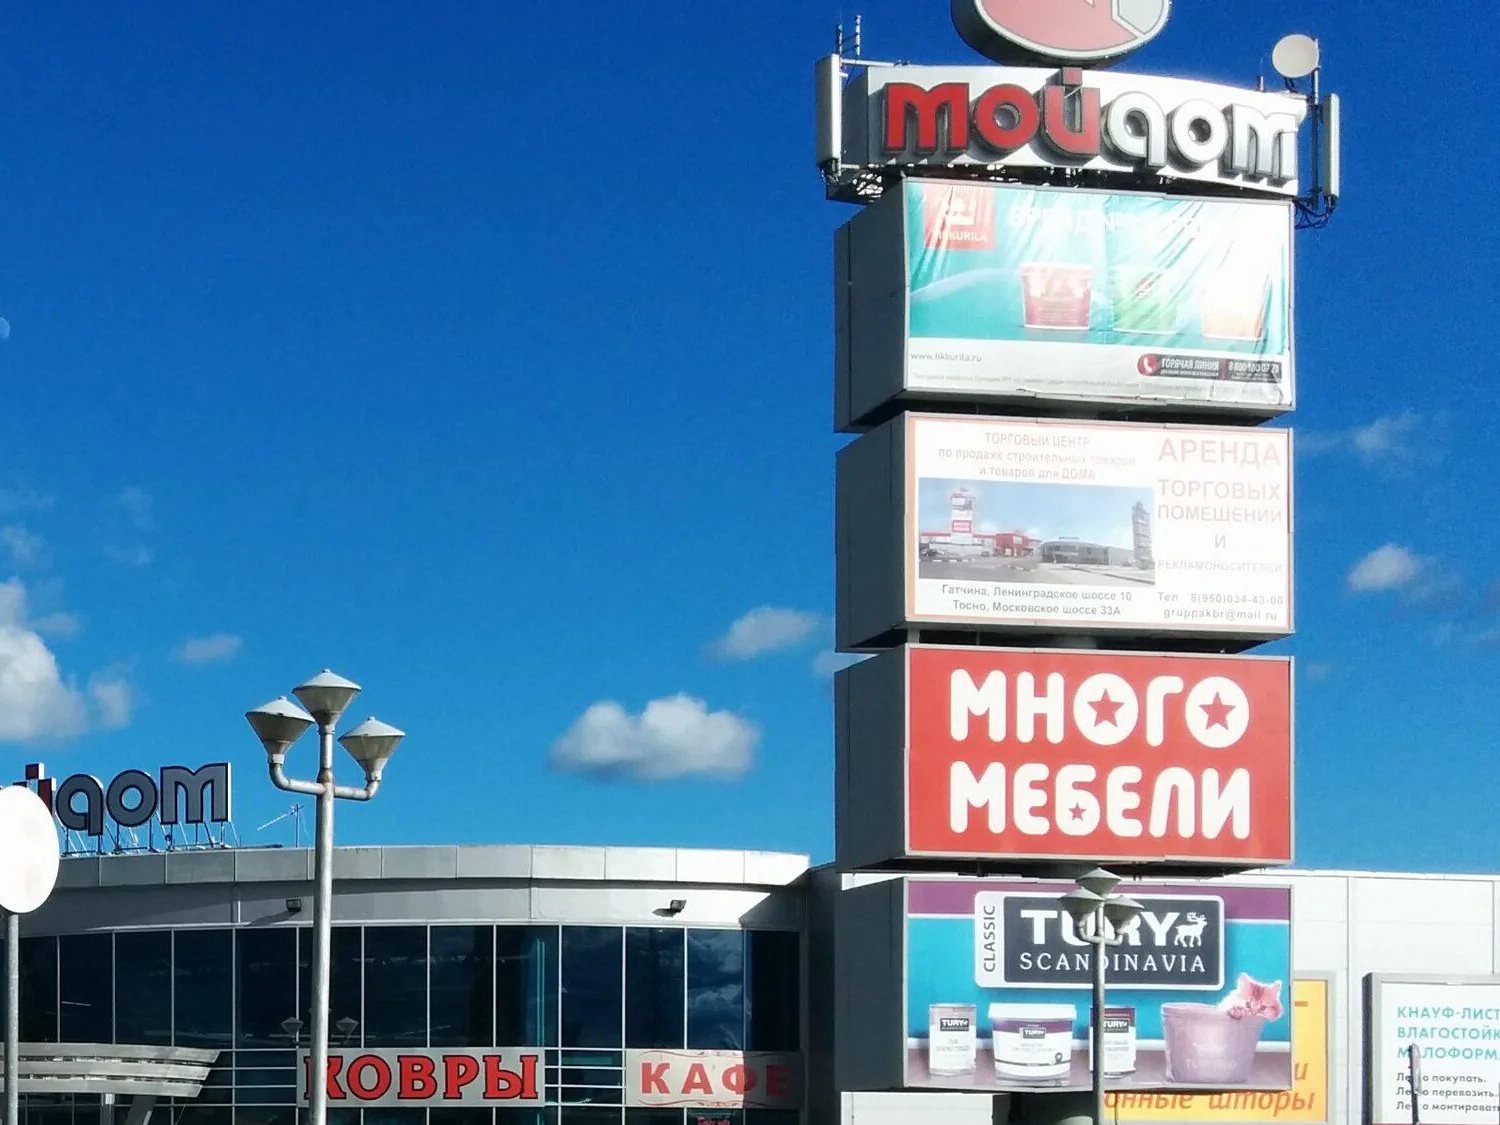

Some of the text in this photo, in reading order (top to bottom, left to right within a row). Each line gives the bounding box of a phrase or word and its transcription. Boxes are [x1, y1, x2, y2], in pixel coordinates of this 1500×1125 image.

[910, 352, 982, 362] www.tikkurila.ru
[1161, 358, 1219, 371] ГОРЯЧАЯ ЛИНИЯ
[985, 432, 1091, 448] ТОРГОВЫЙ ЦЕНТР
[938, 448, 952, 457] по
[955, 449, 1003, 461] продаже
[1006, 451, 1086, 464] строительных
[1158, 438, 1281, 469] АРЕНДА
[989, 467, 1035, 479] товаров
[1038, 470, 1059, 479] для
[1061, 468, 1095, 480] ДОМА
[1158, 479, 1280, 500] ТОРГОВЫХ
[1158, 504, 1282, 523] ПОМЕЩЕНИЙ
[1214, 534, 1226, 549] И
[942, 584, 1132, 601] Гатчина, Ленинградское шоссе 10
[953, 600, 989, 612] Тосно,
[993, 602, 1059, 613] Московское
[1062, 605, 1097, 615] шоссе
[950, 669, 1250, 749] МНОГО
[950, 761, 1251, 840] МЕБЕЛИ
[983, 905, 996, 973] CLASSIC
[1019, 952, 1206, 972] SCANINAVIA
[1397, 1046, 1500, 1060] МЛОФОРМ
[303, 1054, 538, 1100] КОВРЫ
[640, 1062, 790, 1097] КАФЕ
[1396, 1072, 1487, 1084] Лео покупать.
[1396, 1086, 1499, 1099] Лео перевозить.
[1208, 1090, 1315, 1117] шторы
[1396, 1101, 1429, 1110] Лео
